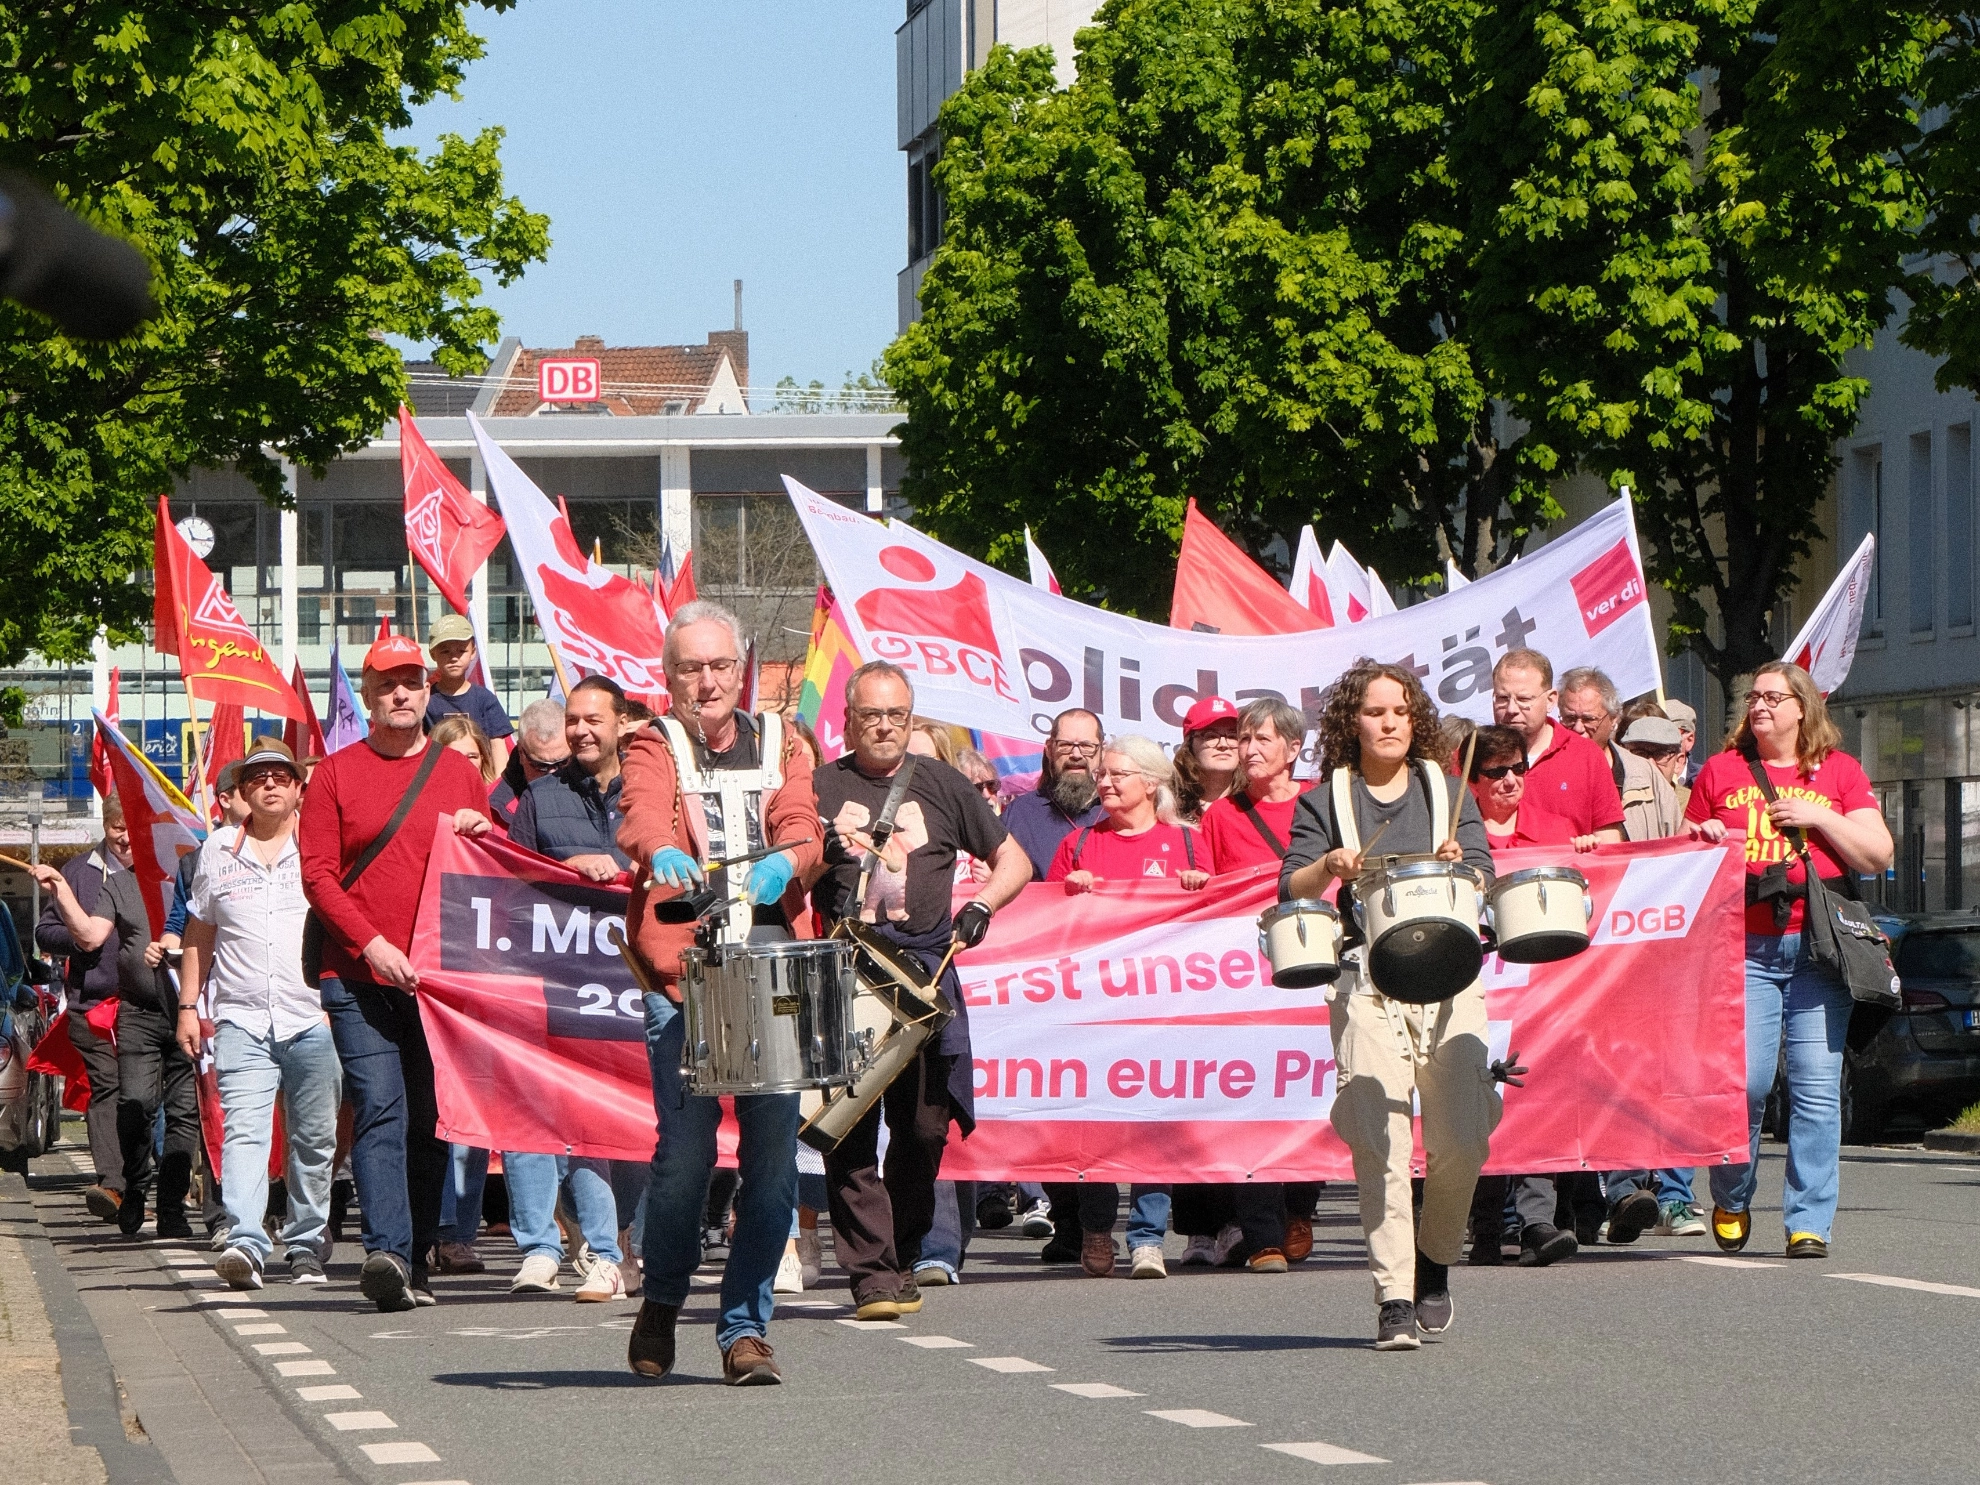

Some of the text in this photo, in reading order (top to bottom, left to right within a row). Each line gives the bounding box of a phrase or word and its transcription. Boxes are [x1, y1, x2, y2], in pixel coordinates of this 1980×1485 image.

[547, 366, 593, 395] DB
[470, 896, 512, 951] 1.
[1611, 904, 1687, 937] DGB
[960, 956, 1082, 1007] Erst
[972, 1058, 1088, 1098] ann
[1106, 1058, 1257, 1099] eure
